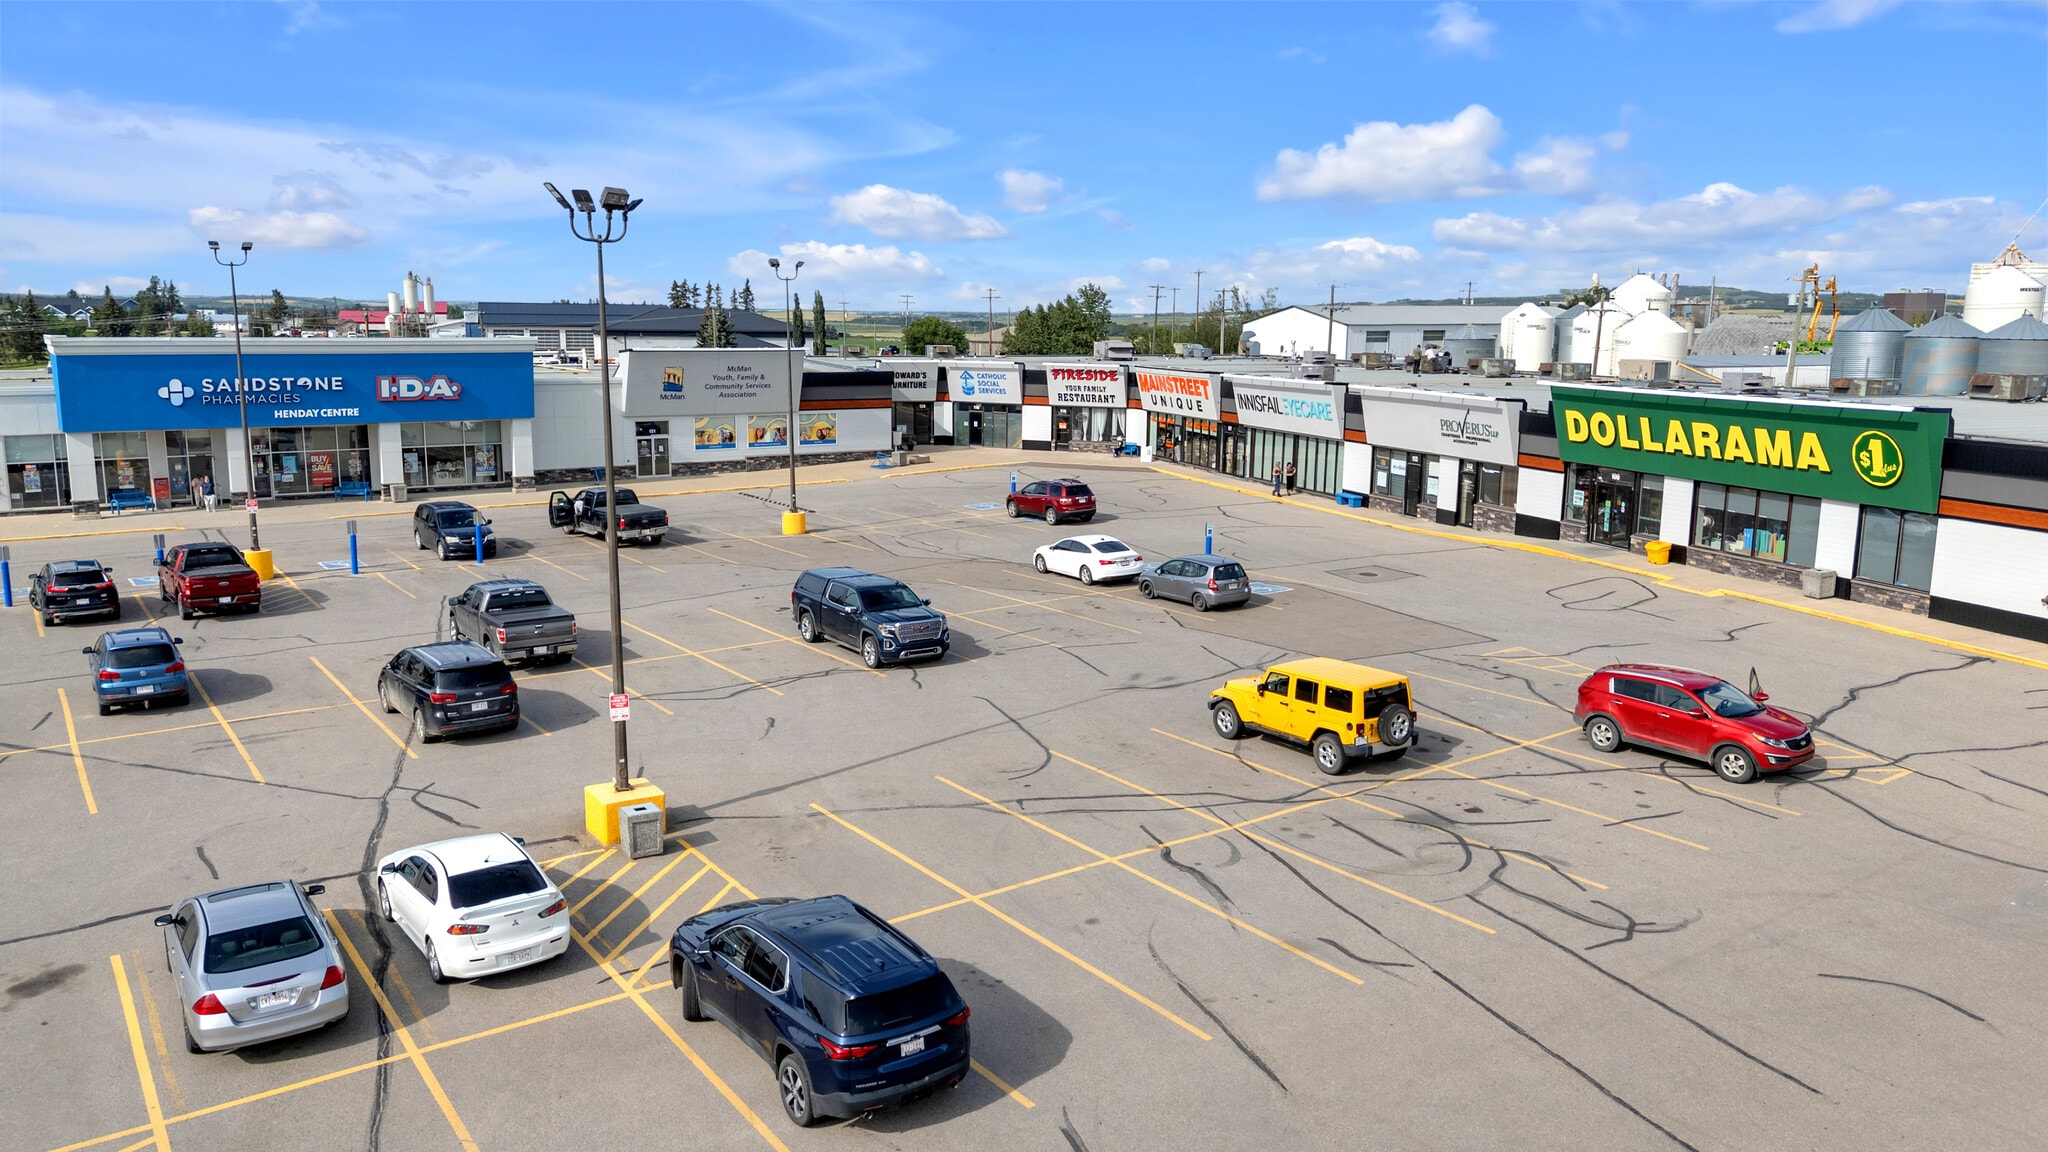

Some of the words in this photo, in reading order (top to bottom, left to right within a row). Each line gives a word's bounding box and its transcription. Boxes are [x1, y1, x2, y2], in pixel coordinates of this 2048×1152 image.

[736, 373, 759, 381] Family
[894, 371, 927, 379] OWARD'S
[976, 372, 1007, 380] CATHOLIC
[1051, 368, 1119, 382] FIRESIDE
[201, 376, 343, 393] SANDSTONE
[892, 381, 928, 389] URNITURE
[977, 380, 1001, 388] SOCIAL
[1083, 385, 1107, 393] FAMILY
[1137, 373, 1209, 400] MAINSTREET
[978, 387, 1007, 395] SERVICES
[202, 393, 300, 405] PHARMACIES
[1057, 393, 1116, 404] RESTAURANT
[1151, 394, 1203, 413] UNIQUE
[274, 408, 320, 418] HENDAY
[320, 408, 360, 417] CENTRE
[1564, 409, 1832, 473] DOLLARAMA
